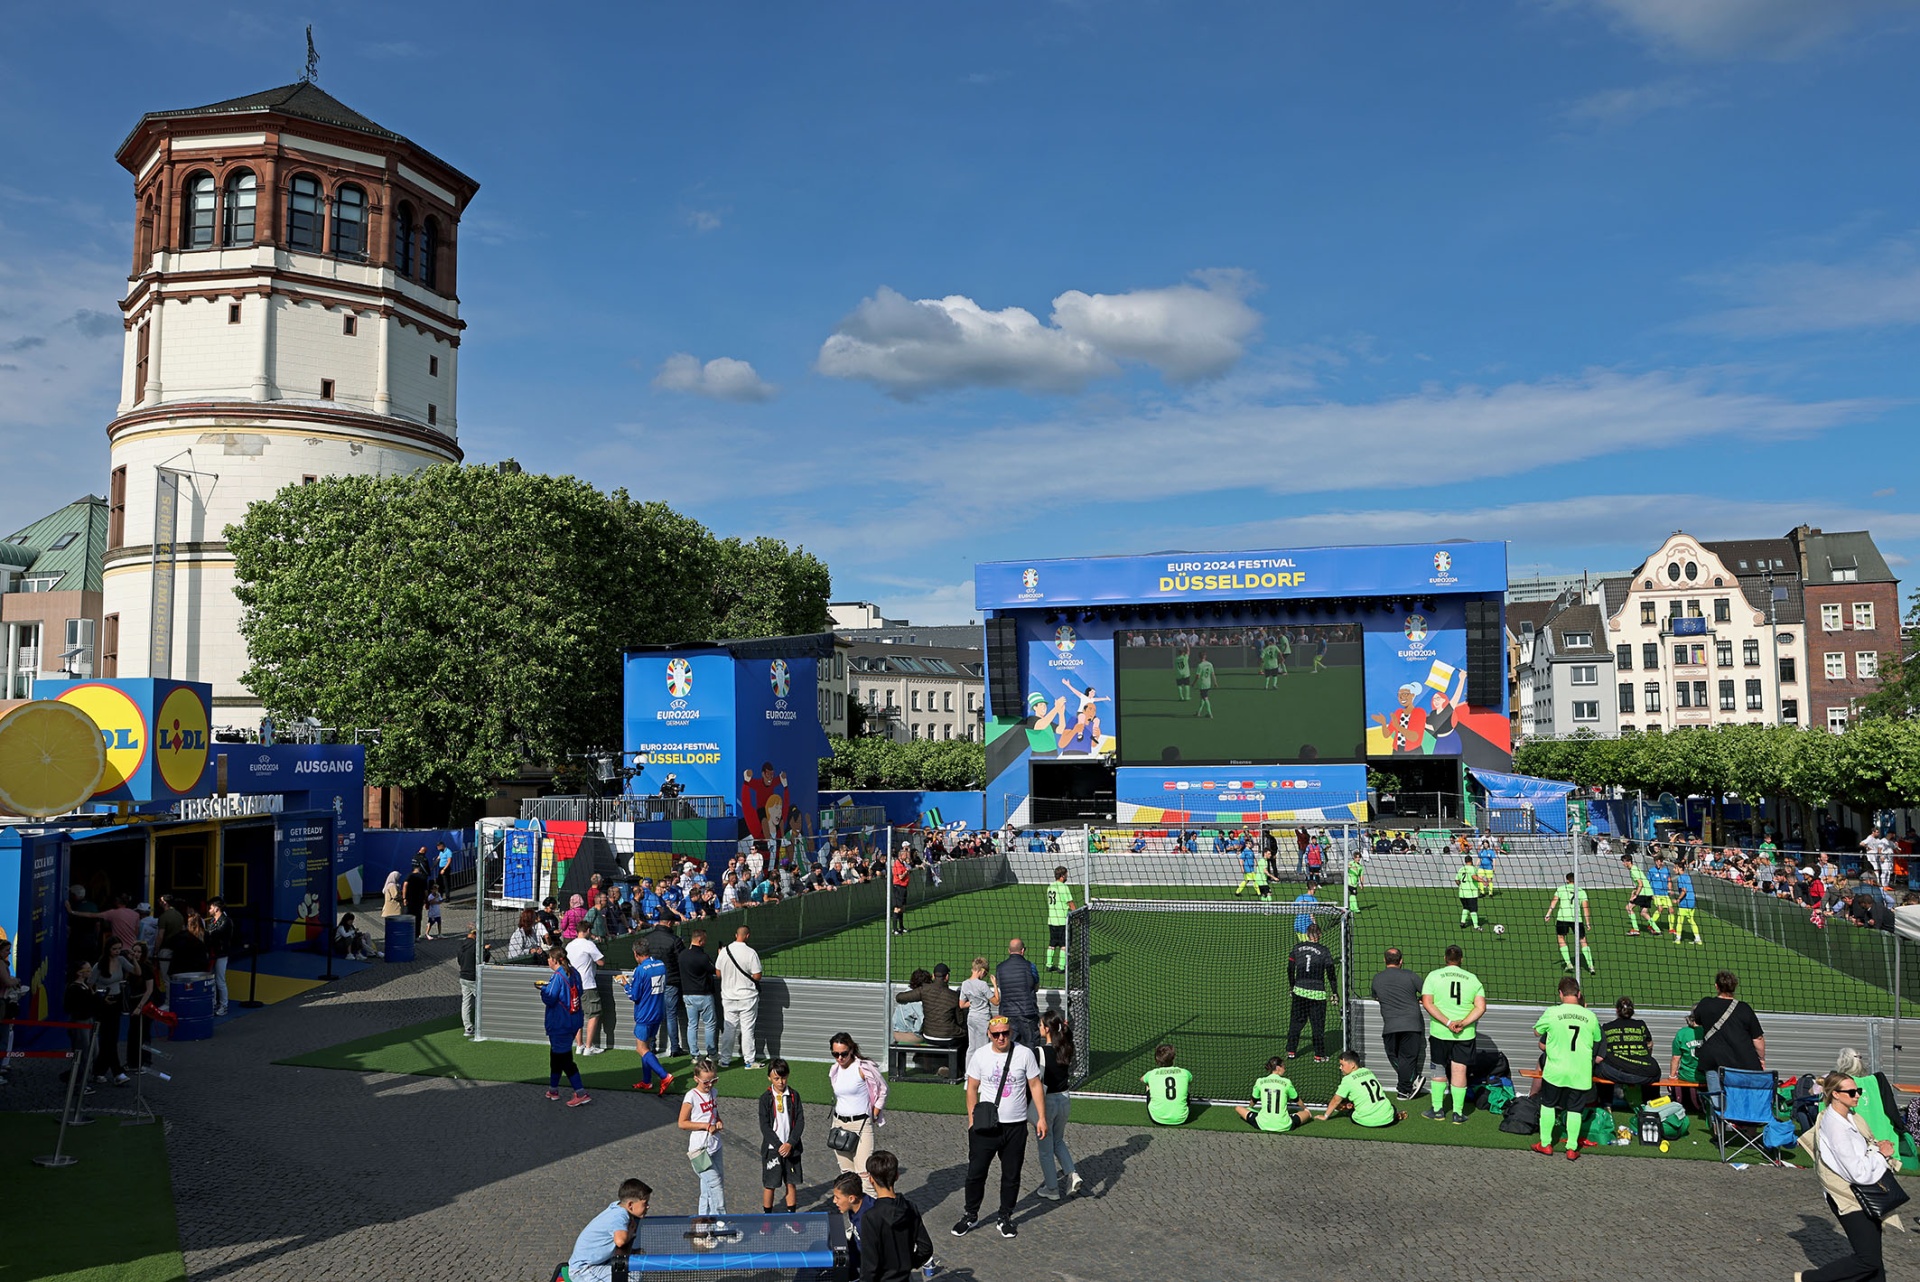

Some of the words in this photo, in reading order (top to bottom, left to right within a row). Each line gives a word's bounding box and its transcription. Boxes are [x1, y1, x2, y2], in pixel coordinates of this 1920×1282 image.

[1167, 562, 1202, 572] EURO
[1203, 560, 1236, 571] 2024
[1238, 558, 1297, 570] FESTIVAL
[1159, 572, 1306, 592] DÜSSELDORF
[1398, 649, 1437, 657] EURO2024
[1048, 659, 1084, 667] EURO2024
[656, 710, 700, 720] EURO2024
[765, 710, 797, 720] EURO2024
[101, 728, 138, 750] DL
[640, 743, 662, 751] EURO
[662, 743, 682, 751] 2024
[683, 743, 720, 751] FESTIVAL
[643, 751, 721, 764] ÜSSELDORF
[294, 760, 353, 773] AUSGANG
[290, 828, 302, 836] GET
[303, 826, 323, 835] READY
[1462, 872, 1467, 883] 2
[1305, 954, 1311, 972] 1
[1450, 981, 1461, 1005] 4
[1569, 1025, 1580, 1052] 7
[1165, 1076, 1176, 1101] 8
[1361, 1079, 1385, 1104] 12
[1264, 1088, 1281, 1114] 11
